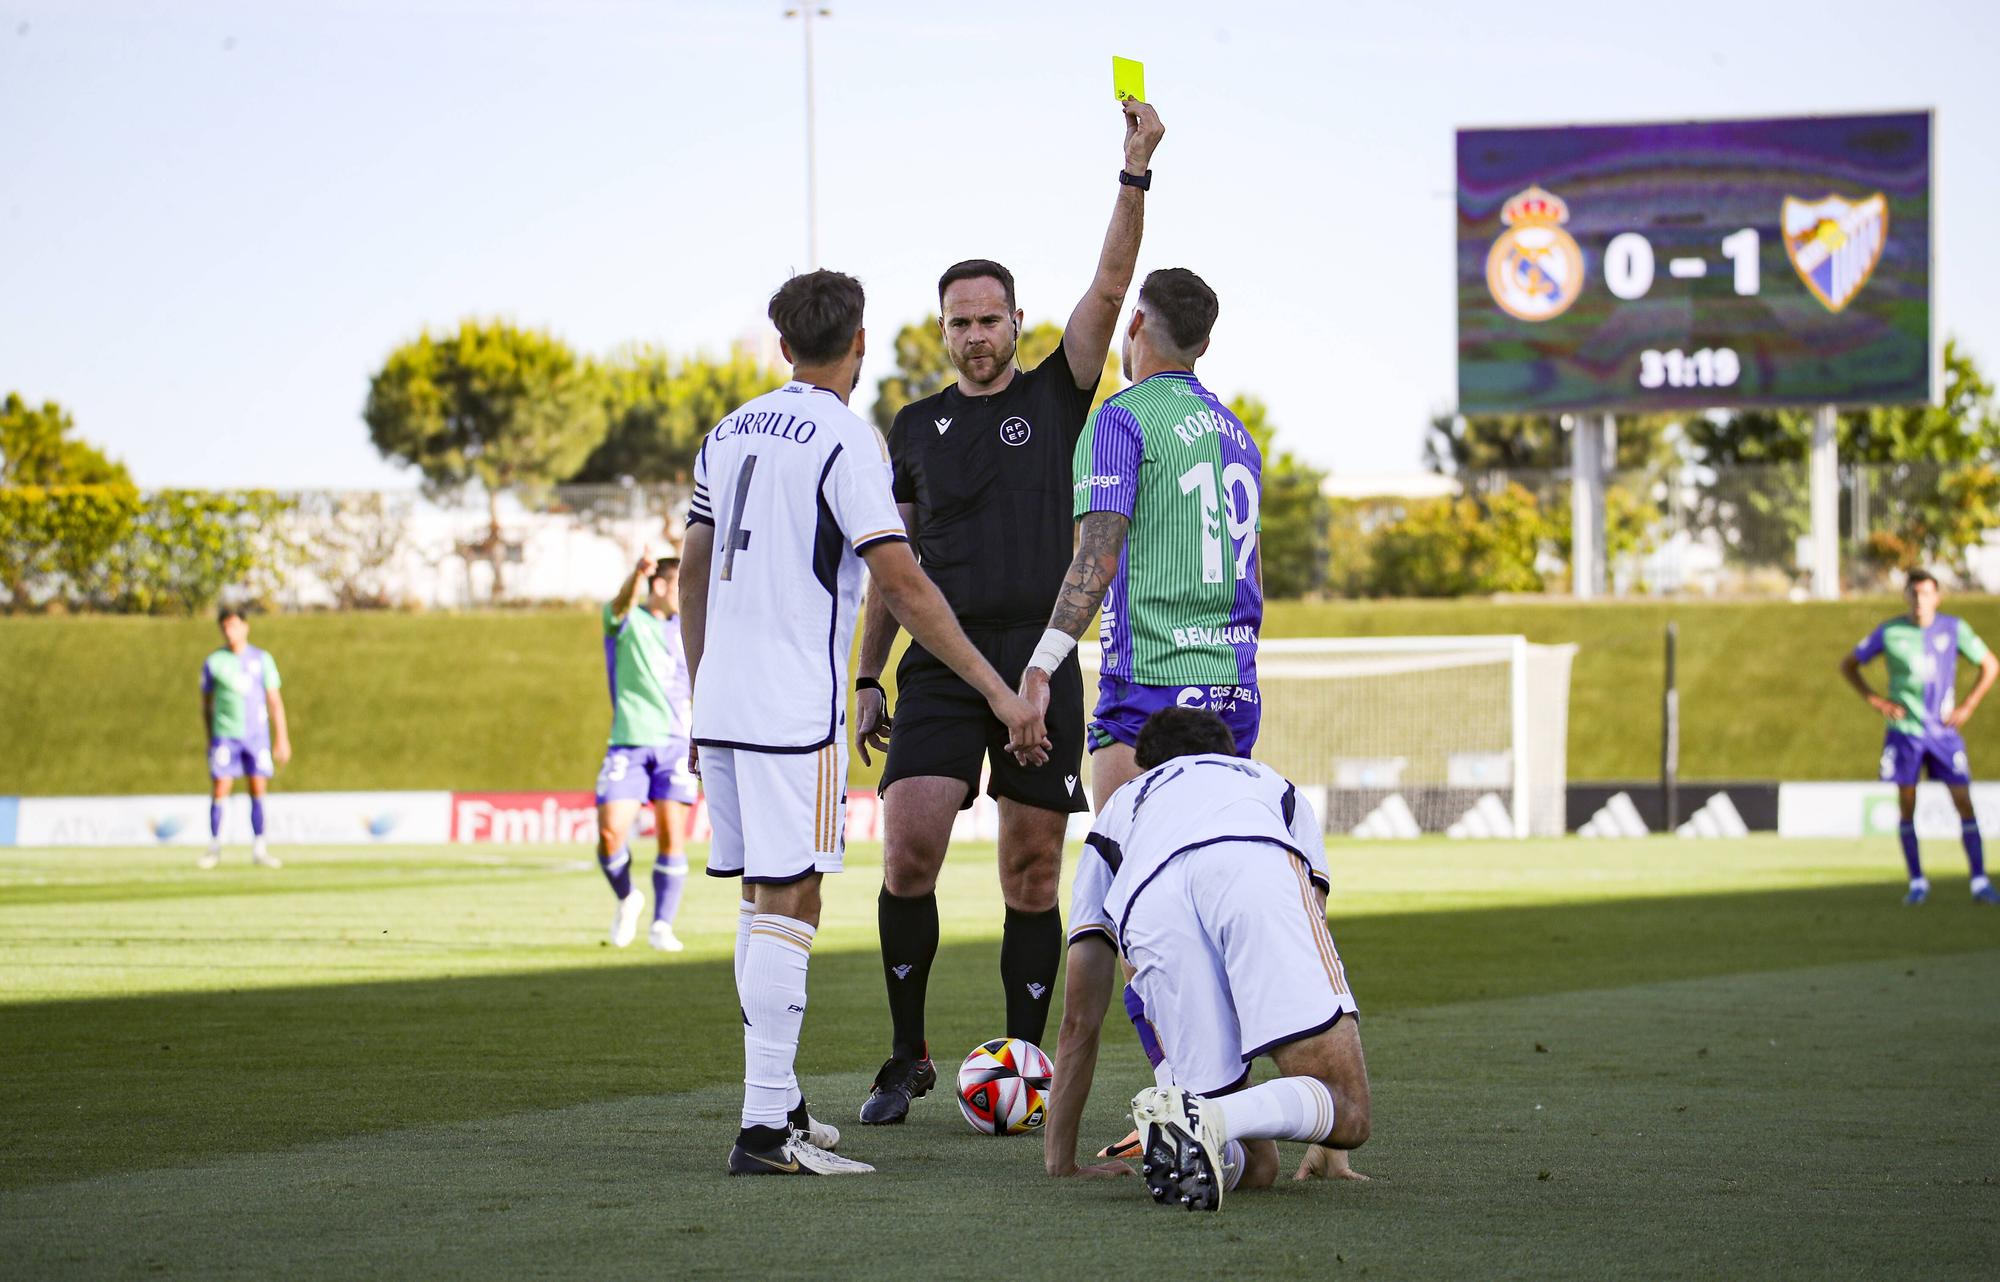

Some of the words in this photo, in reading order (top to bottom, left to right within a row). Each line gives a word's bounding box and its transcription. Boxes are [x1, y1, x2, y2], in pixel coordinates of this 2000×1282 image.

[1604, 232, 1655, 299] 0
[1721, 228, 1761, 296] 1
[1639, 347, 1740, 388] 31:19
[715, 411, 816, 444] CARRILLO
[1174, 411, 1247, 450] ROBERTO
[1178, 461, 1260, 584] 19
